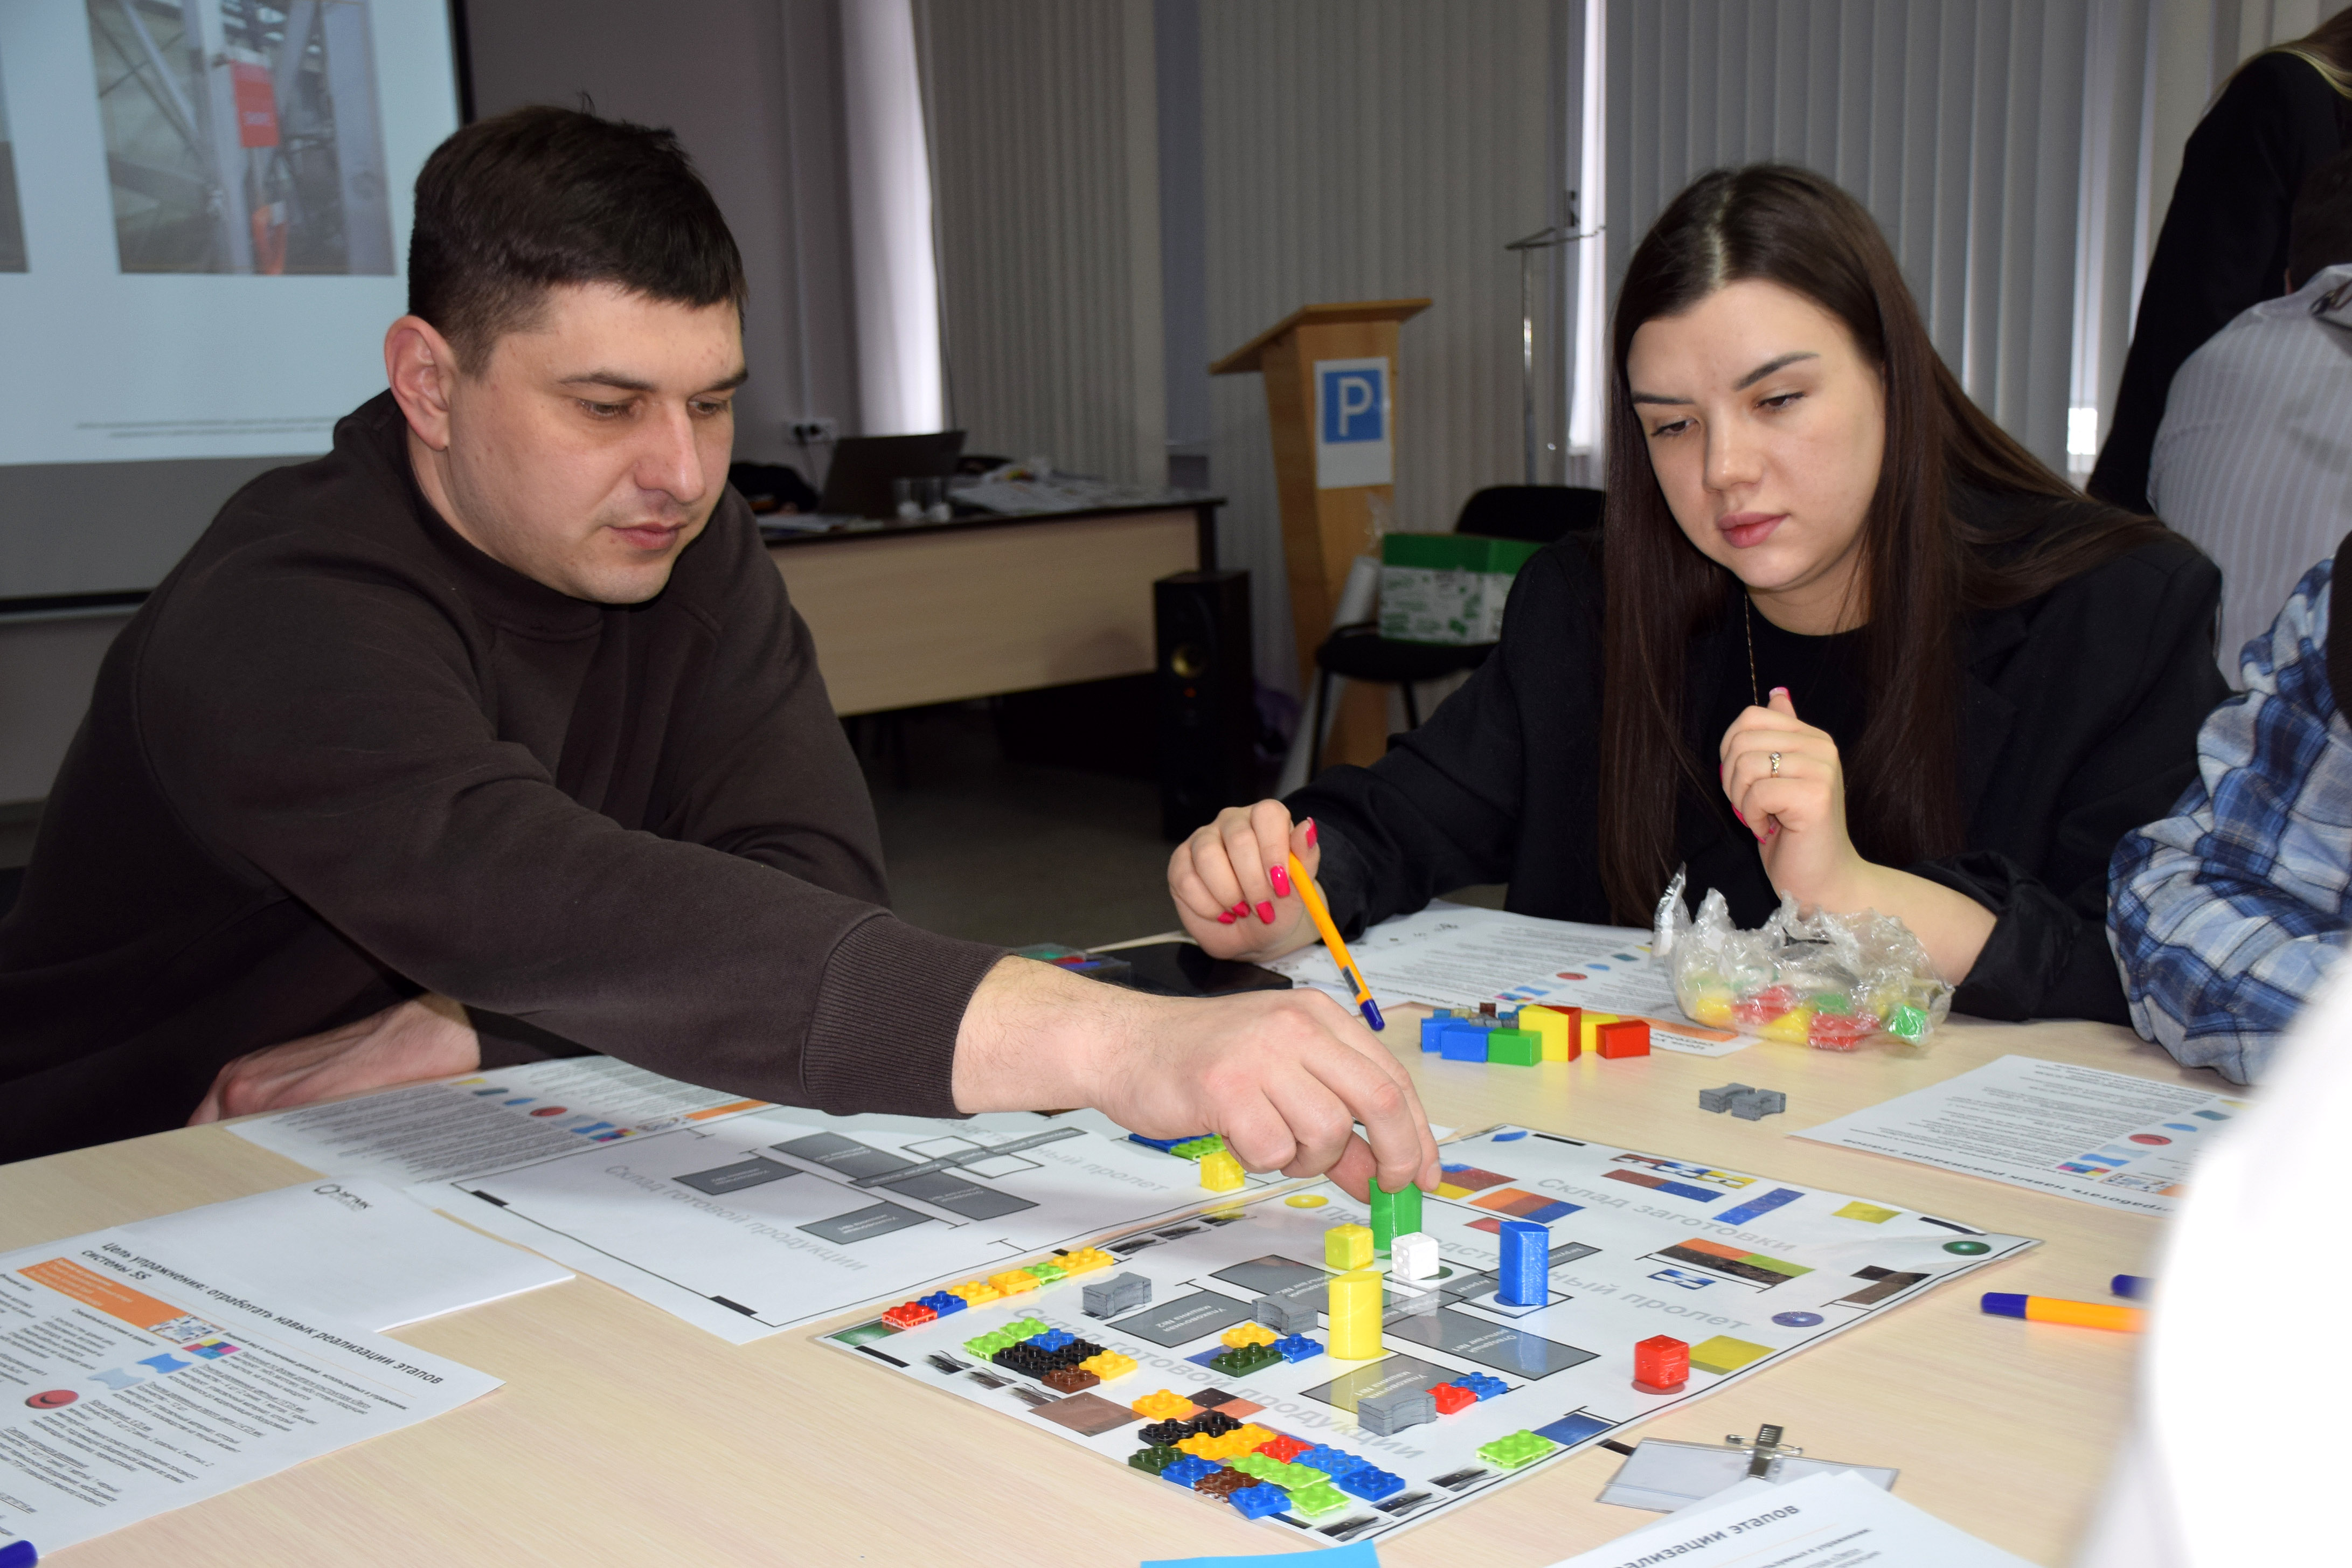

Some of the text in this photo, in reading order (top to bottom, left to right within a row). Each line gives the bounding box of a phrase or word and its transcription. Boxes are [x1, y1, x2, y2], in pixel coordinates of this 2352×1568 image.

[1337, 377, 1373, 437] P
[1843, 1139, 1894, 1151] этапов
[1083, 1163, 1171, 1191] пролет
[1902, 1151, 2004, 1178] реализации
[2009, 1174, 2067, 1190] навык
[605, 1164, 662, 1192] Склад
[663, 1189, 745, 1224] готовой
[745, 1220, 869, 1271] продукции
[1538, 1178, 1798, 1253] Склад заготовки
[81, 1249, 129, 1274] системы
[1456, 1280, 1491, 1293] Агрегат
[102, 1242, 131, 1259] Цель
[129, 1254, 208, 1291] упражнения:
[207, 1287, 273, 1320] отработать
[274, 1315, 318, 1335] навык
[313, 1330, 396, 1365] реализации
[393, 1361, 445, 1384] этапов
[1155, 1305, 1212, 1329] машина №2
[1162, 1308, 1228, 1332] Упаковочная
[1620, 1293, 1752, 1330] пролет
[1451, 1329, 1509, 1352] рольганг №1
[1109, 1342, 1240, 1389] готовой
[1354, 1370, 1412, 1396] машина №1
[1727, 1504, 1801, 1535] этапов
